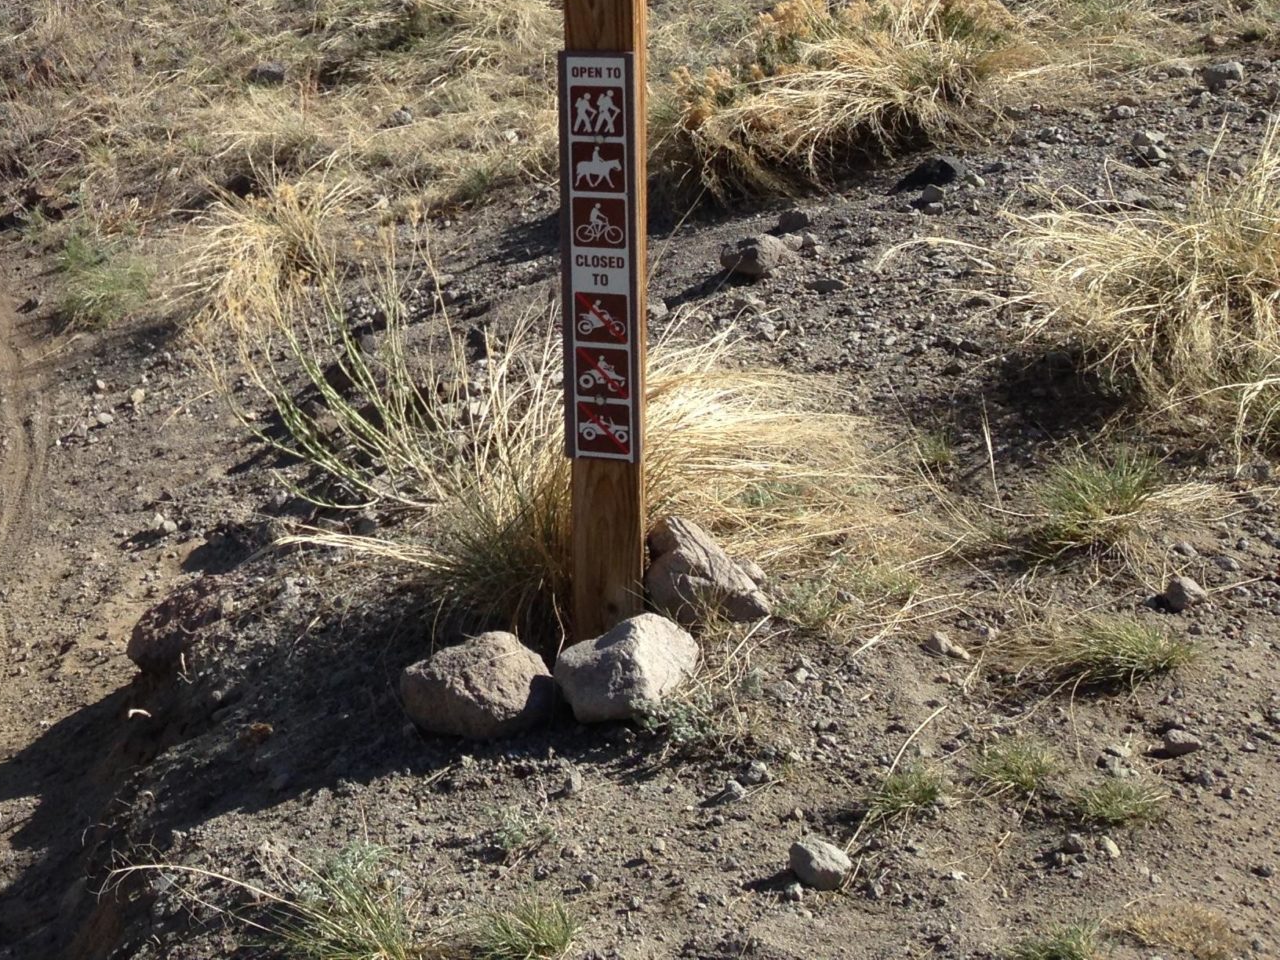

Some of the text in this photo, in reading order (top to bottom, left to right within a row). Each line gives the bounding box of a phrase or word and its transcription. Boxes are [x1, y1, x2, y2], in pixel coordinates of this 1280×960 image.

[571, 66, 621, 79] OPEN TO
[575, 254, 625, 269] CLOSED
[592, 273, 609, 286] TO
